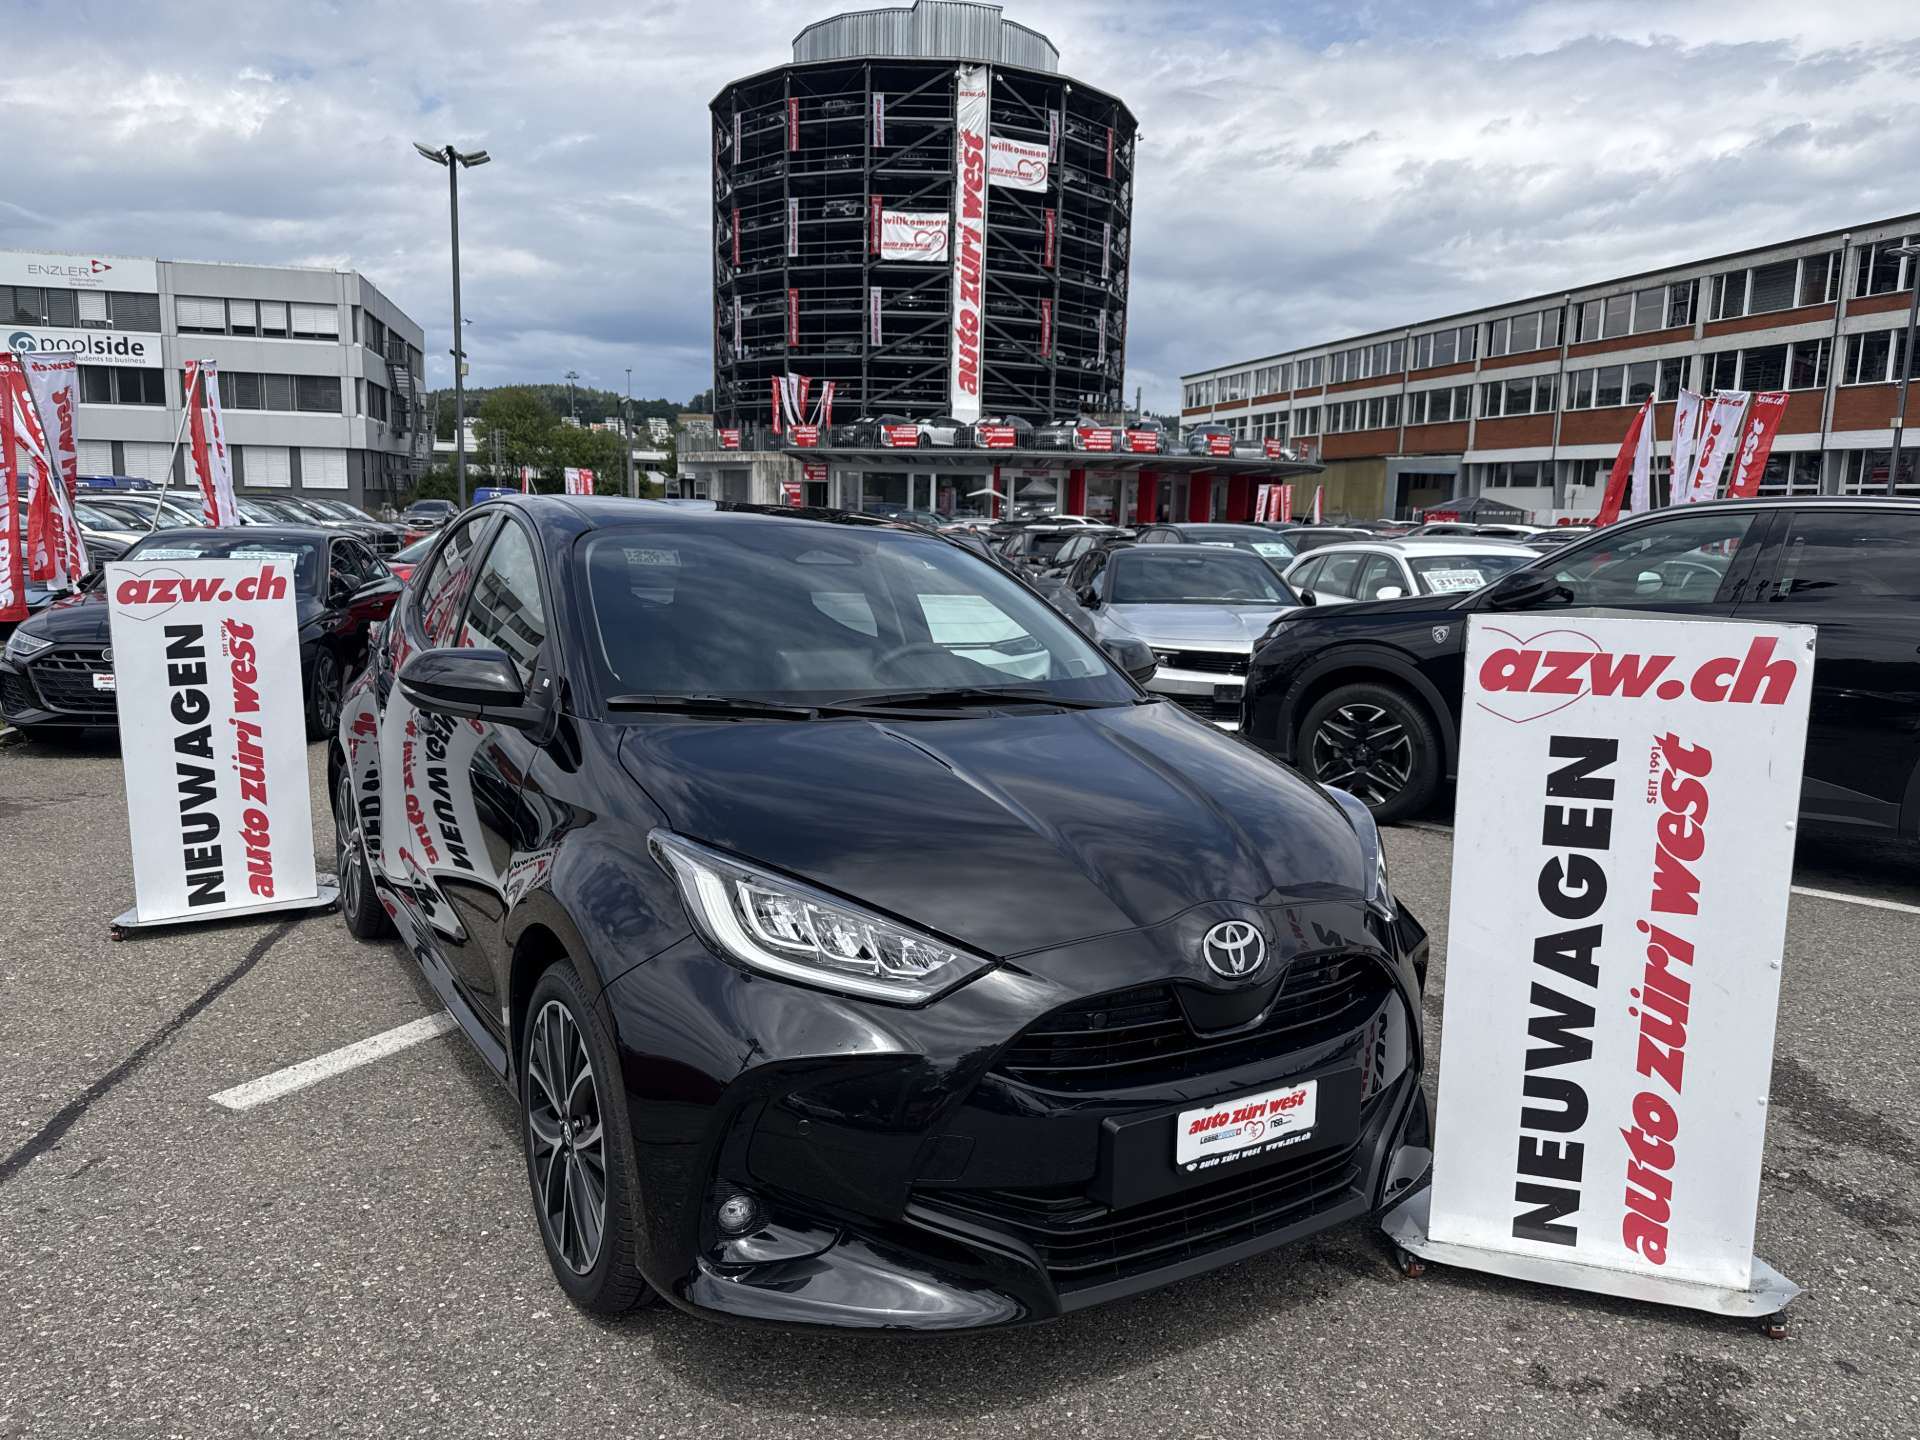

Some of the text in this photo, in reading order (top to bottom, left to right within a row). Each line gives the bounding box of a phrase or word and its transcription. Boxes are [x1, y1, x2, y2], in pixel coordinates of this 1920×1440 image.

[991, 142, 1047, 158] willkommen
[883, 216, 947, 227] willkommen
[27, 264, 90, 278] ENZLER
[955, 128, 984, 396] auto züri west
[40, 334, 145, 357] poolside
[114, 356, 146, 364] business
[116, 565, 287, 605] azw.ch
[1479, 636, 1798, 705] azw.ch
[163, 624, 226, 907] NEUWAGEN
[220, 617, 275, 898] auto züri west
[1646, 745, 1662, 804] SEIT 1991
[1511, 735, 1619, 1248] NEUWAGEN
[1618, 731, 1713, 1266] auto züri west
[1188, 1089, 1307, 1135] auto züri west
[1199, 1132, 1312, 1169] auto züri west www.azw.ch
